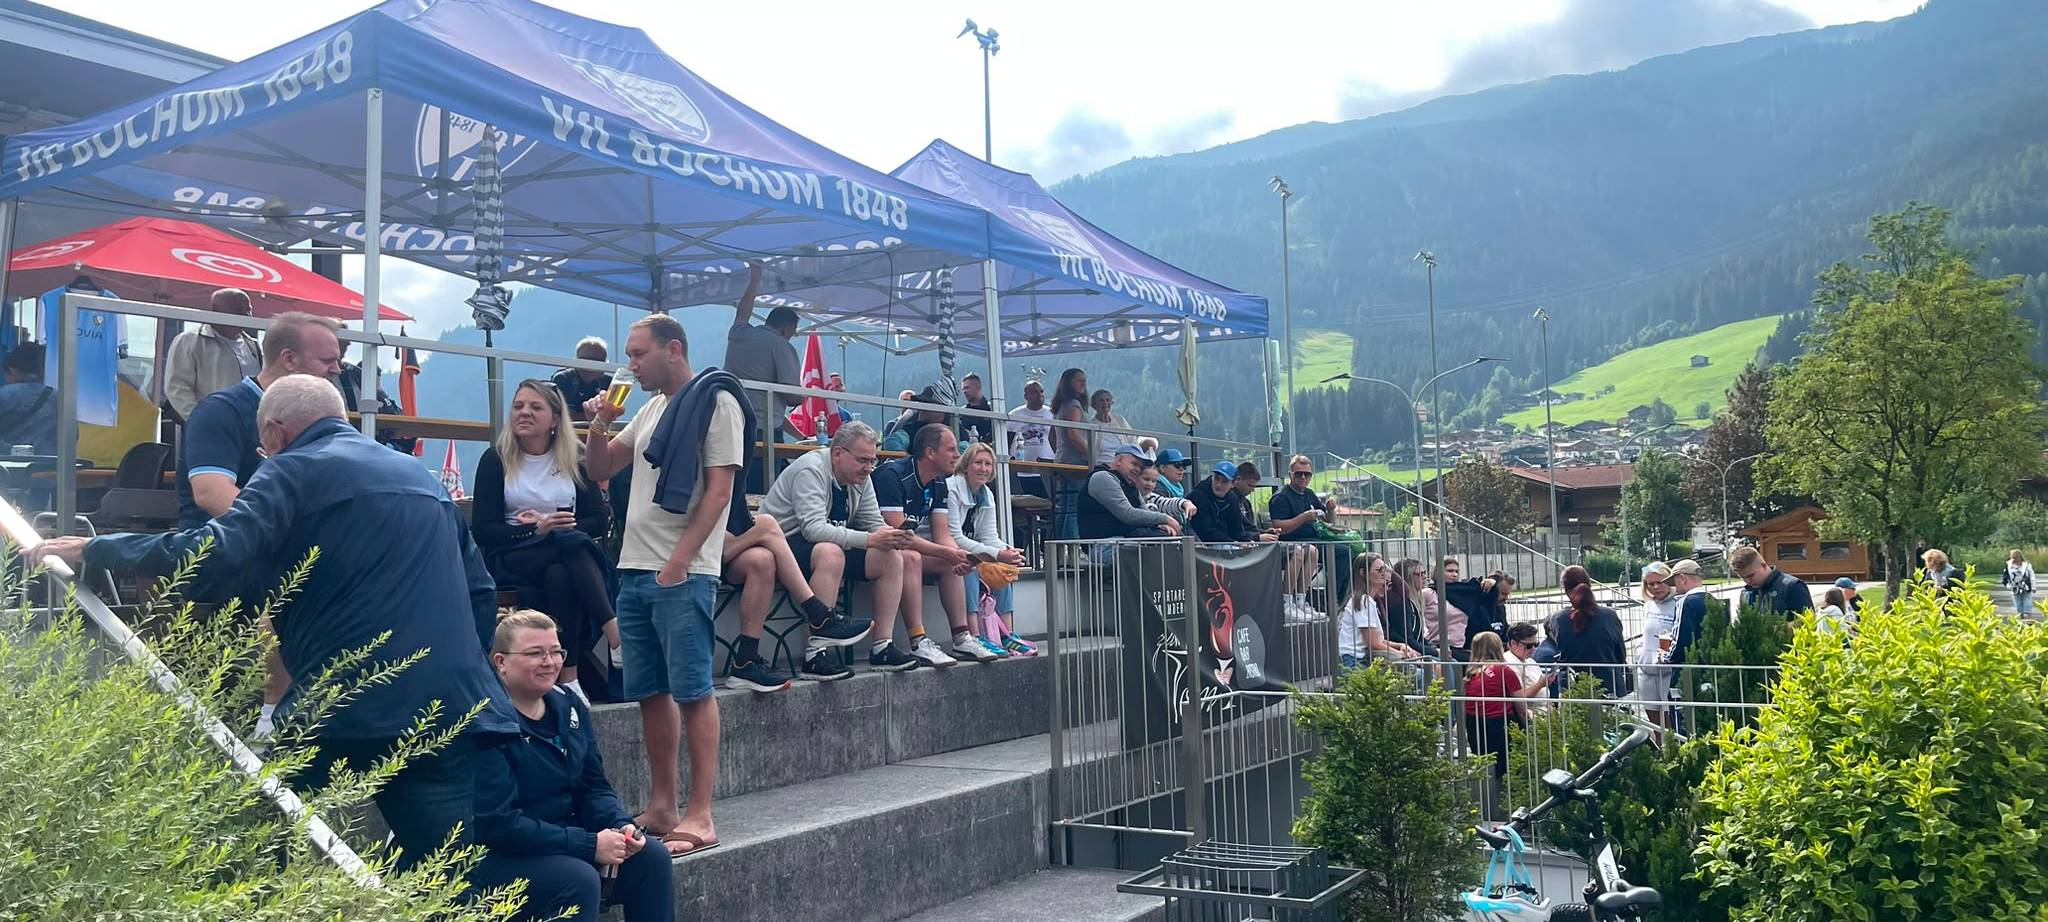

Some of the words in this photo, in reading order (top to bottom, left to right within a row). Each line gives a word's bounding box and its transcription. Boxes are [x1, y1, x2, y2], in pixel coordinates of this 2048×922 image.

[263, 30, 353, 108] 1848
[541, 95, 618, 158] VfL
[629, 129, 823, 210] BOCHUM
[836, 177, 909, 231] 1848
[1049, 246, 1090, 282] VfL
[1091, 258, 1184, 311] BOCHUM
[1186, 288, 1228, 322] 1848
